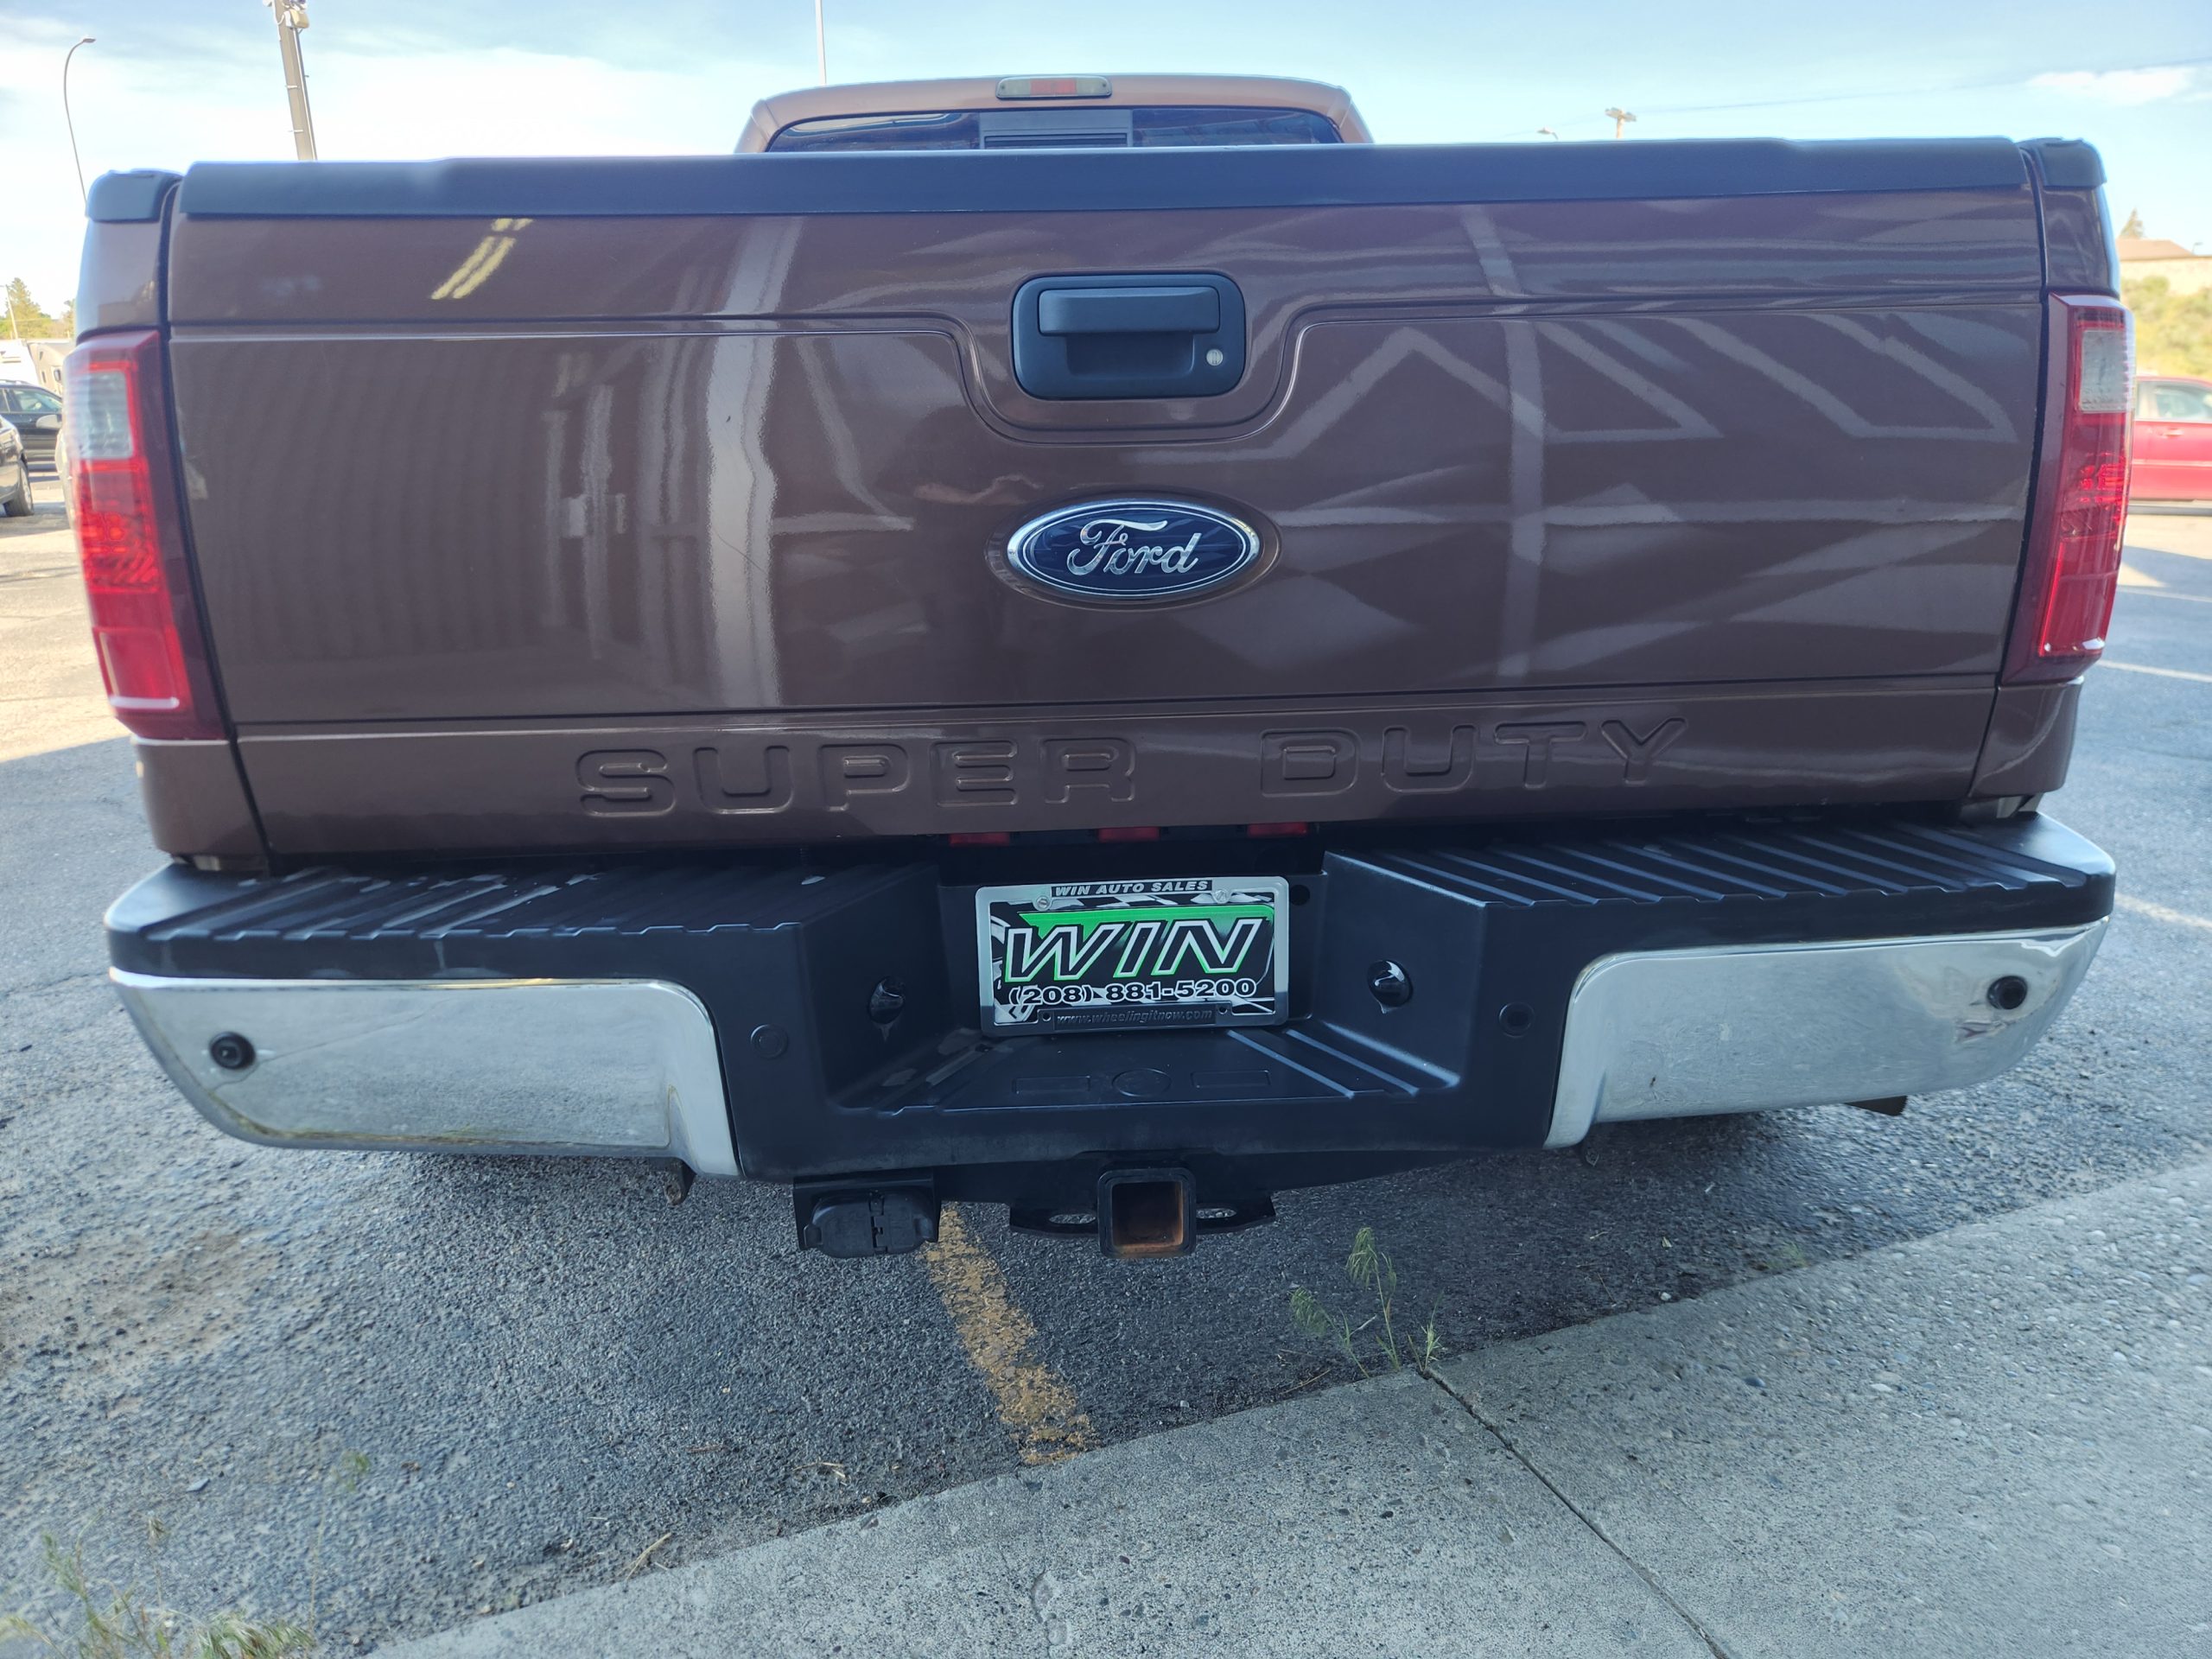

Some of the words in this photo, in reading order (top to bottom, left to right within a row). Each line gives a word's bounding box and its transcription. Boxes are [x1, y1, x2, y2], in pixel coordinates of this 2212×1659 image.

[1066, 518, 1202, 575] Ford
[575, 739, 1136, 817] SUPER
[1260, 717, 1688, 798] DUTY
[1055, 885, 1090, 897] WIN
[1096, 882, 1145, 895] AUTO
[1151, 880, 1209, 893] SALES
[1004, 918, 1264, 983] WIN
[1008, 985, 1094, 1006] (208)
[1104, 977, 1257, 1002] 881-5200
